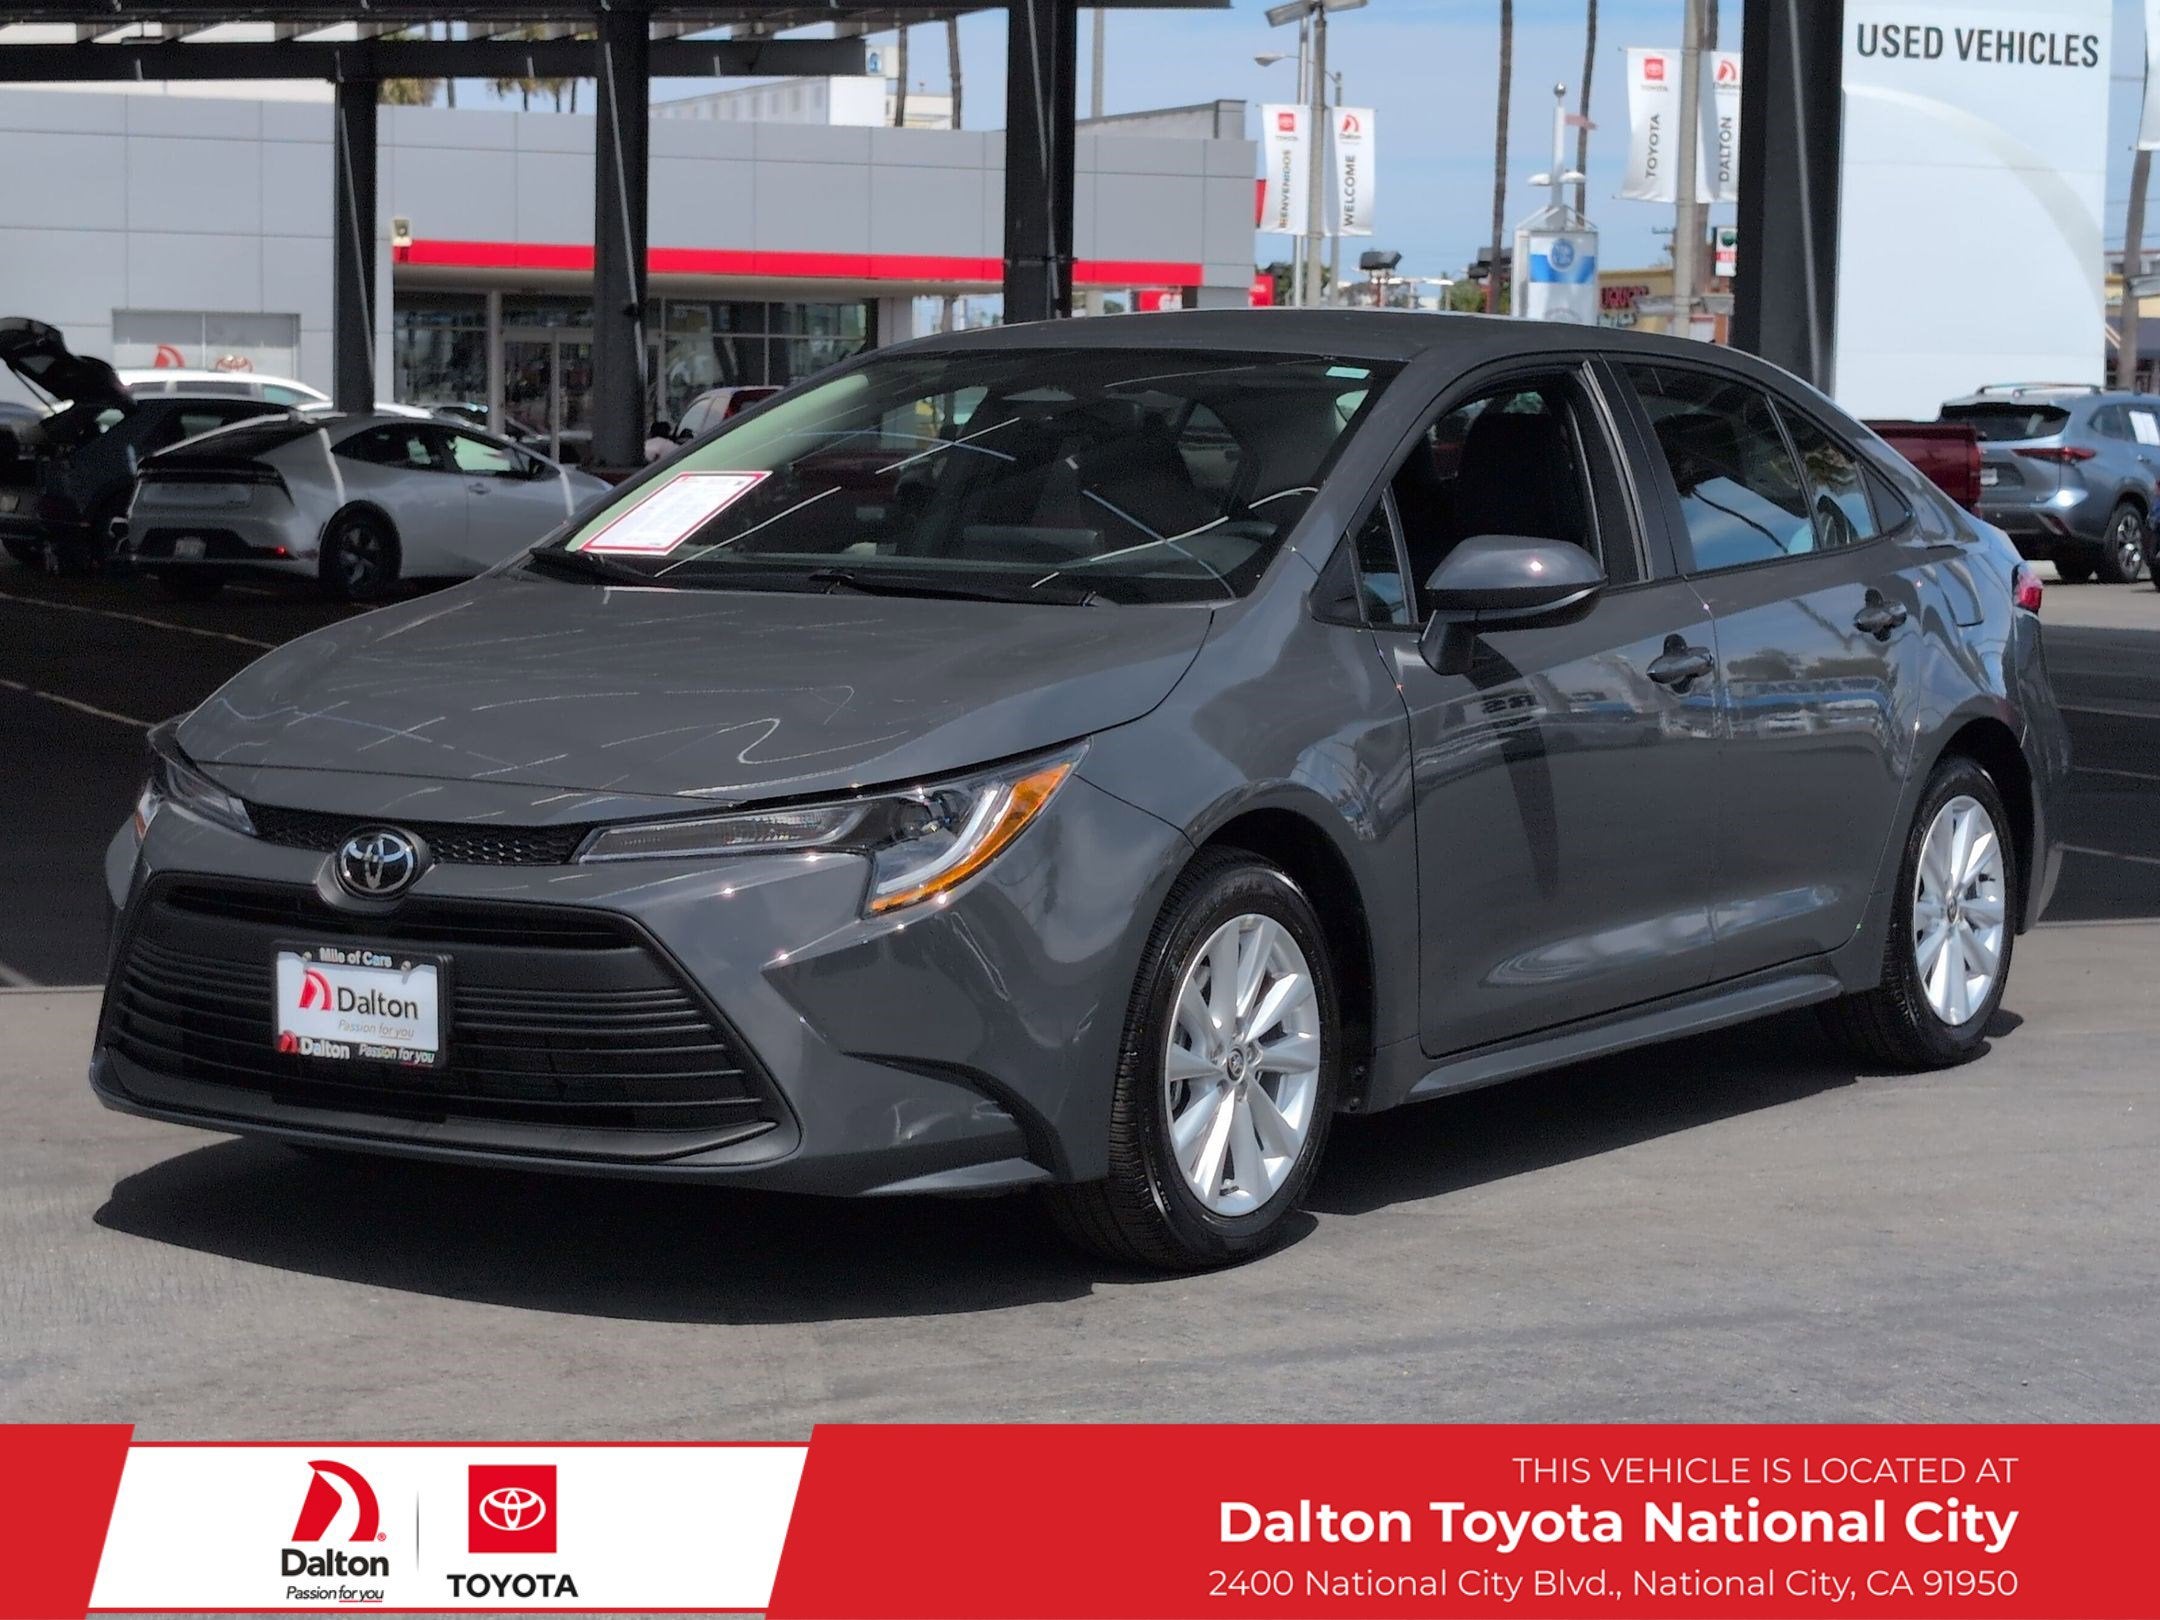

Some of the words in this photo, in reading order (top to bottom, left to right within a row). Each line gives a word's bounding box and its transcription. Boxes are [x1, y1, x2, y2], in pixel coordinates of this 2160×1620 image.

[1857, 23, 1943, 59] USED
[1955, 28, 2099, 68] VEHICLES
[1645, 113, 1661, 178] TOYOTA
[1719, 117, 1732, 182] DALTON
[1343, 154, 1357, 227] WELCOME
[320, 948, 345, 963] Mile
[347, 951, 361, 965] of
[362, 951, 392, 968] Cars
[337, 986, 418, 1020] Dalton
[338, 1019, 376, 1034] Passion
[378, 1024, 393, 1036] for
[394, 1028, 415, 1039] you
[300, 1037, 350, 1059] Dalton
[359, 1043, 397, 1059] Passion
[398, 1048, 414, 1061] for
[414, 1051, 435, 1064] you
